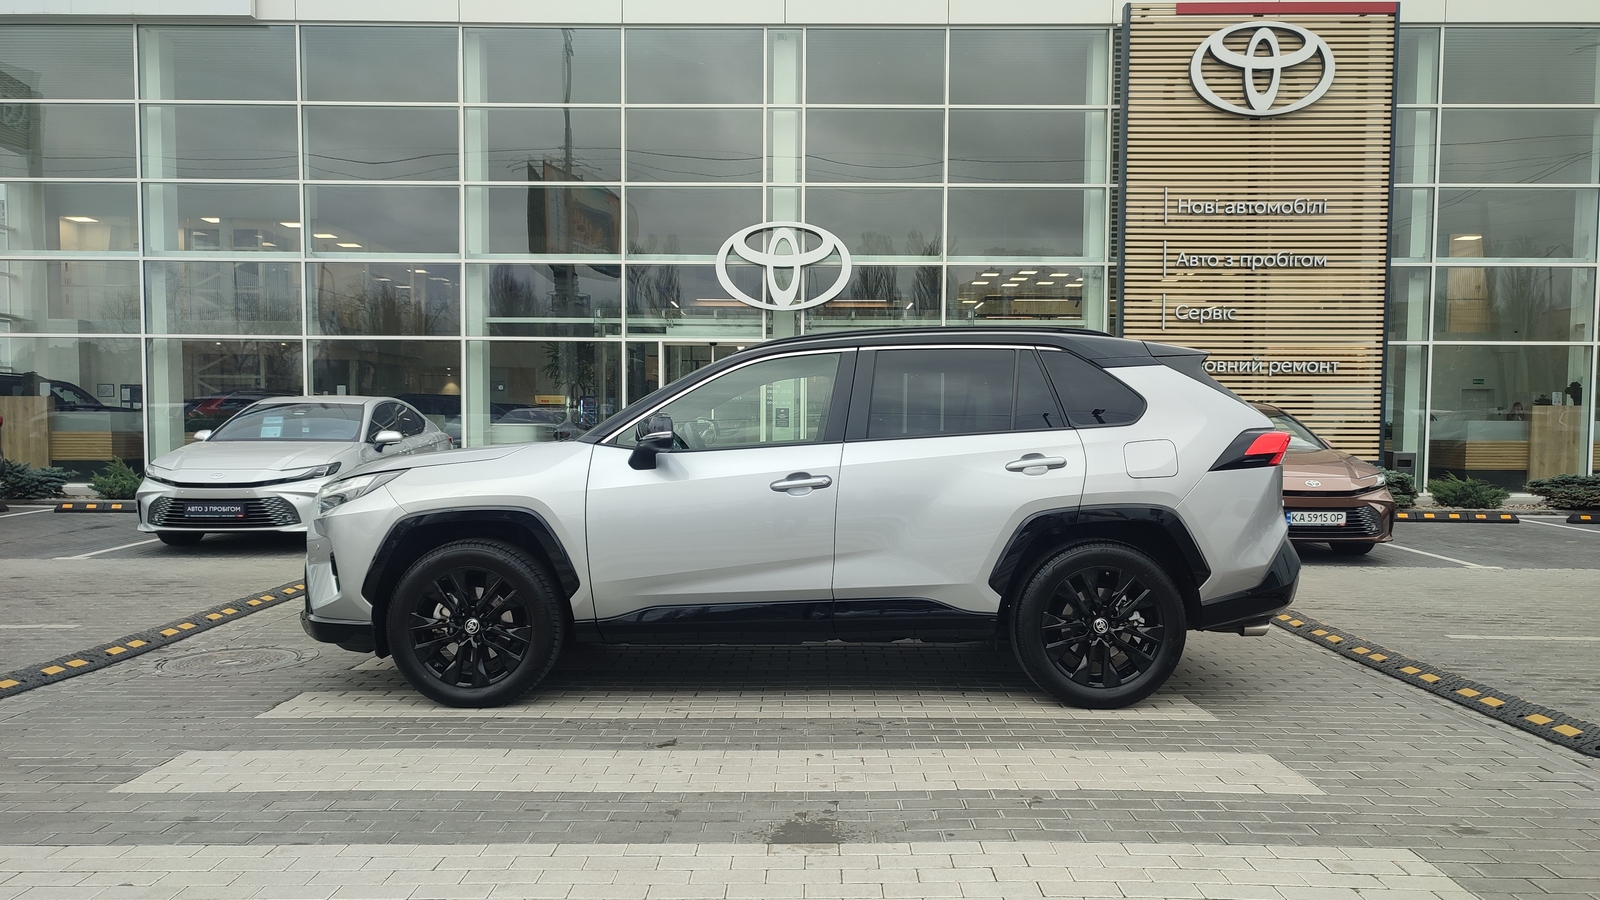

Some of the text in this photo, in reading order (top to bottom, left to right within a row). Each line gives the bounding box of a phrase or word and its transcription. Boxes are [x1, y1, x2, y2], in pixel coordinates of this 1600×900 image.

[1177, 197, 1328, 214] Нові автомобілі
[1175, 250, 1328, 271] Авто з пробігом
[1175, 304, 1238, 324] Сервіс
[1268, 361, 1340, 376] ремонт
[1292, 513, 1344, 522] KA 5915 OP
